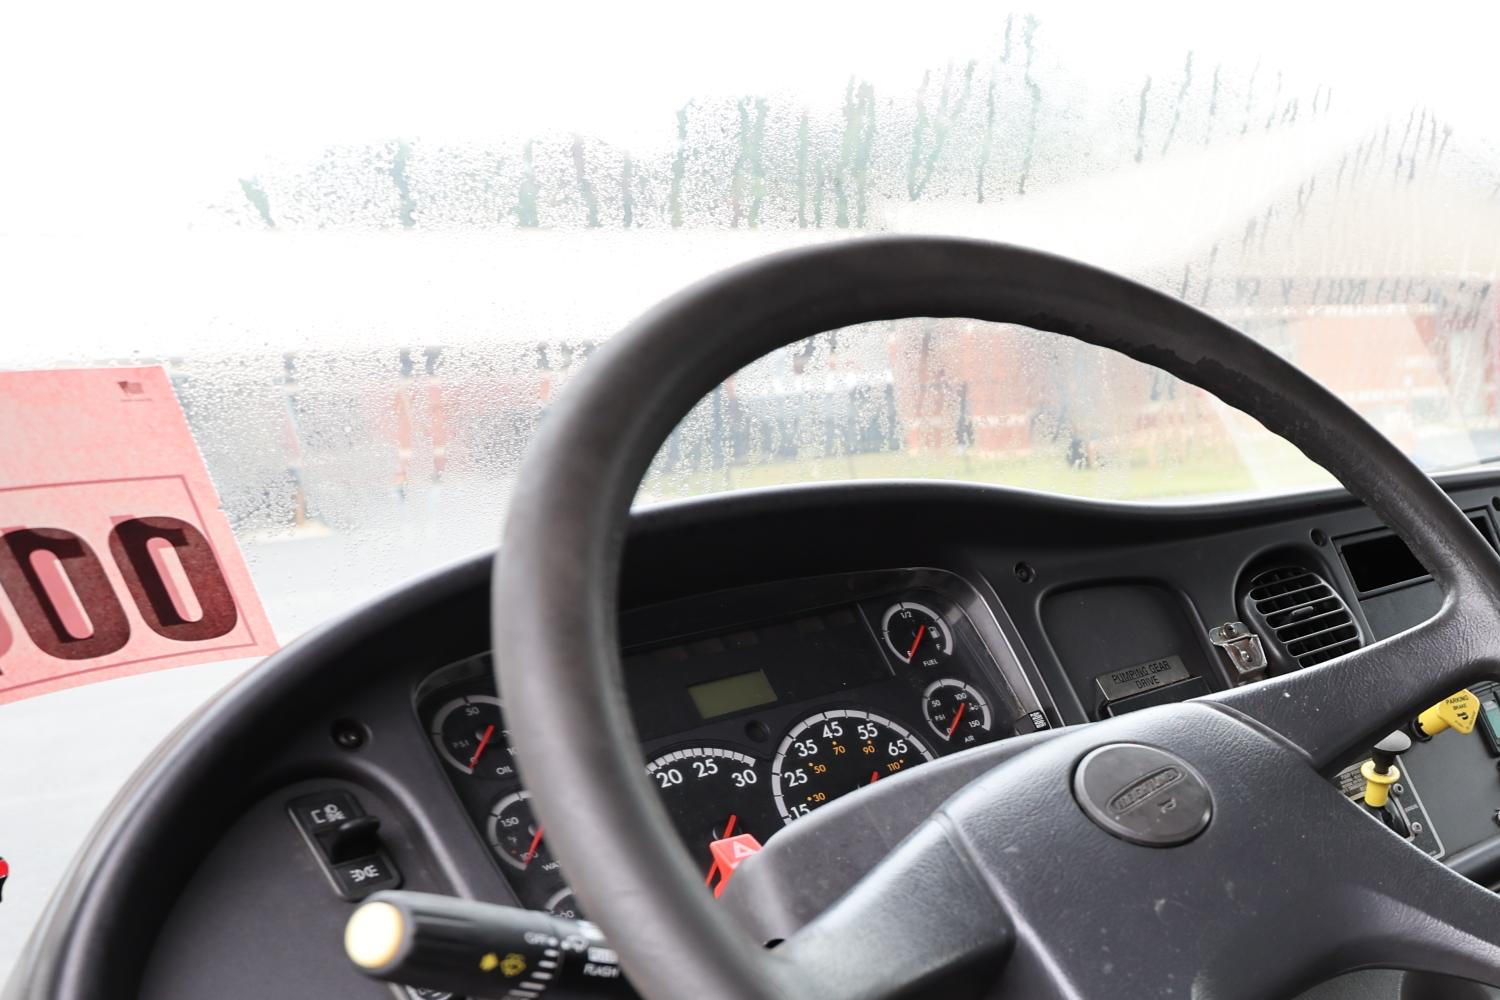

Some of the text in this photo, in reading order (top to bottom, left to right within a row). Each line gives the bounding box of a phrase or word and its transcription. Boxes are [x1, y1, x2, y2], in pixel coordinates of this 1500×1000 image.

[923, 659, 938, 667] FUEL
[1112, 660, 1170, 682] PUMPING GEAR
[1136, 677, 1160, 689] DRIVE
[931, 699, 941, 707] 50
[1446, 695, 1469, 704] PARKING
[465, 706, 479, 716] 50
[968, 720, 980, 728] 150
[822, 722, 843, 739] 45
[857, 723, 878, 740] 55
[964, 735, 975, 743] AIR
[794, 739, 818, 757] 35
[834, 745, 845, 755] 70
[862, 745, 875, 754] 90
[888, 739, 908, 756] 65
[496, 766, 513, 775] OIL
[692, 759, 719, 778] 25
[814, 764, 826, 773] 50
[887, 762, 901, 771] 110
[656, 769, 683, 788] 20
[731, 772, 757, 787] 30
[784, 769, 808, 787] 25
[813, 792, 826, 802] 30
[790, 804, 811, 819] 15
[501, 817, 519, 827] 150
